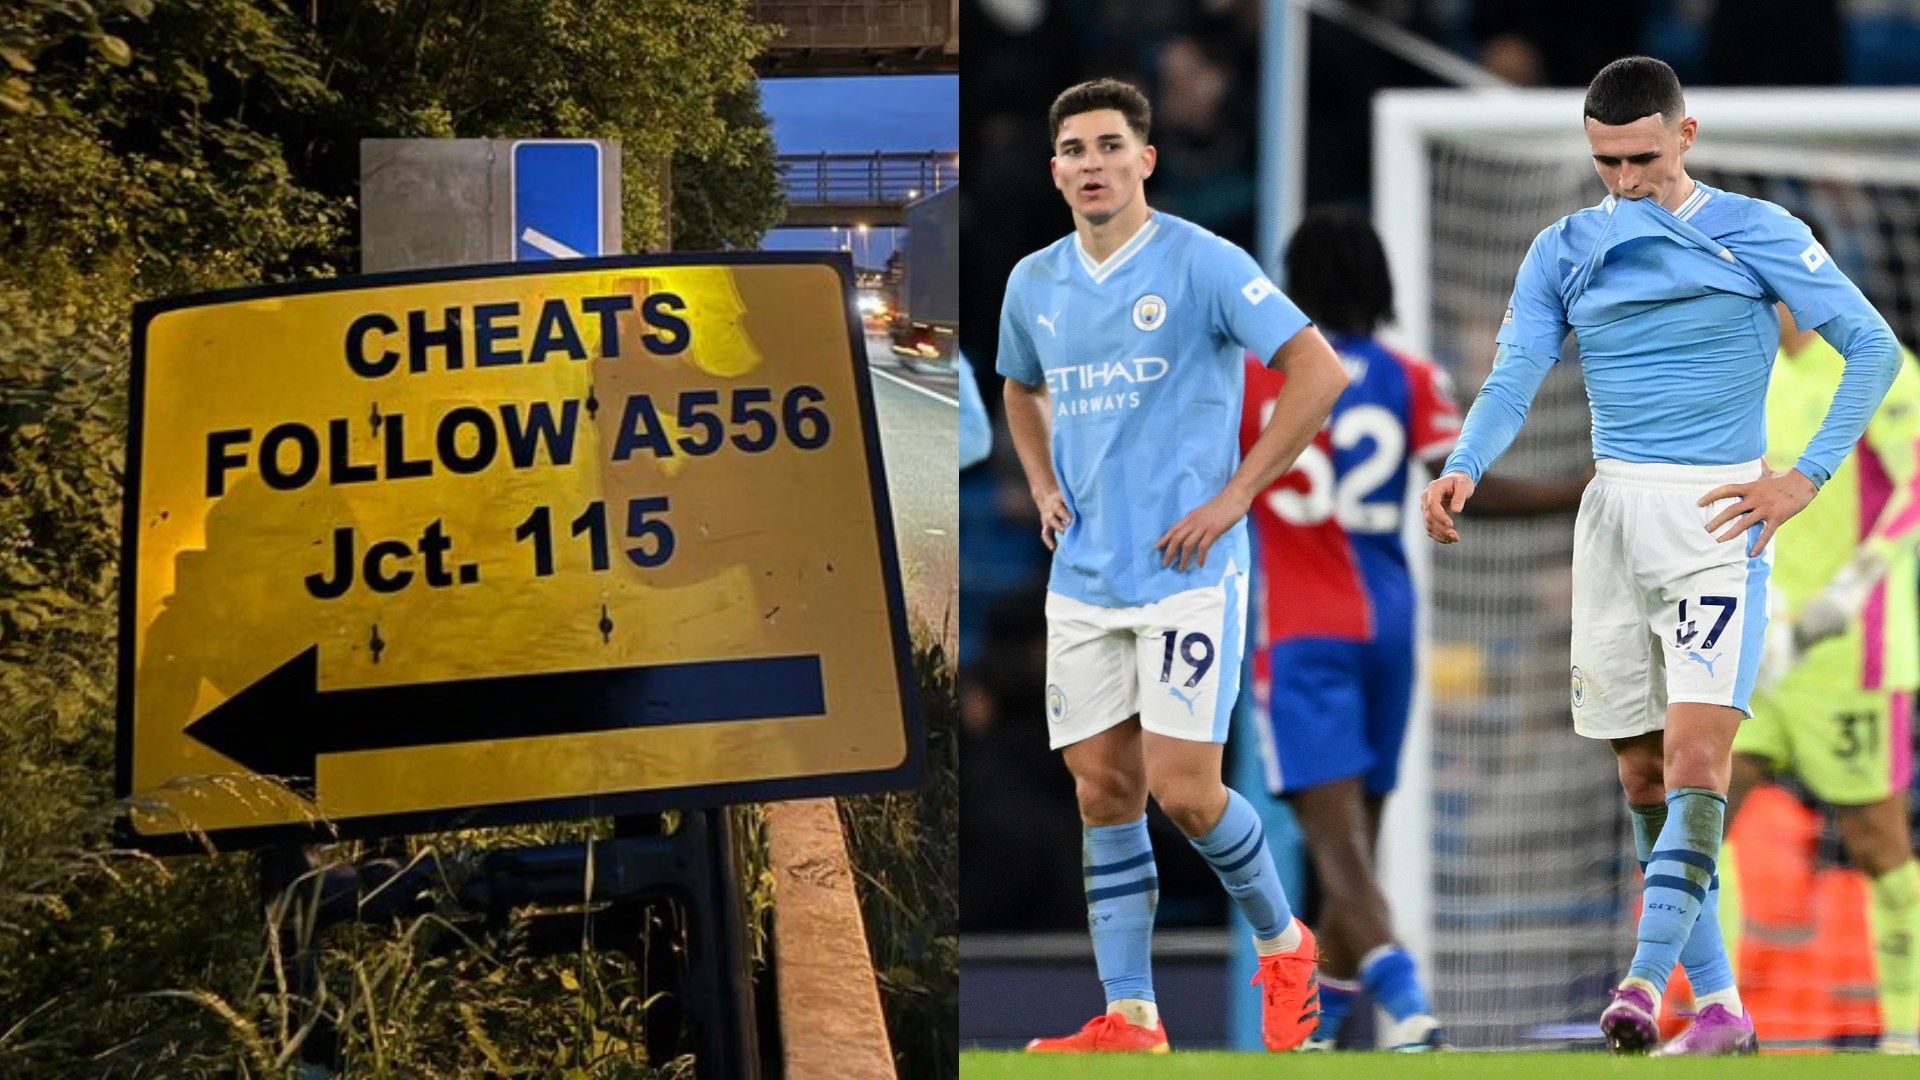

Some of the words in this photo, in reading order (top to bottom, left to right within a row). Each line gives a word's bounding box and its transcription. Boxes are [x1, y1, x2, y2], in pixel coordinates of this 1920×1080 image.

[345, 293, 690, 378] CHEATS
[1044, 357, 1169, 393] ETIHAD
[1058, 392, 1140, 416] AIRWAYS
[206, 398, 580, 498] FOLLOW
[611, 385, 831, 461] A556
[304, 519, 479, 600] Jct.
[516, 496, 676, 577] 115
[1675, 596, 1737, 650] 47
[1160, 630, 1215, 688] 19
[1834, 712, 1878, 758] 31
[1649, 903, 1687, 915] CITY
